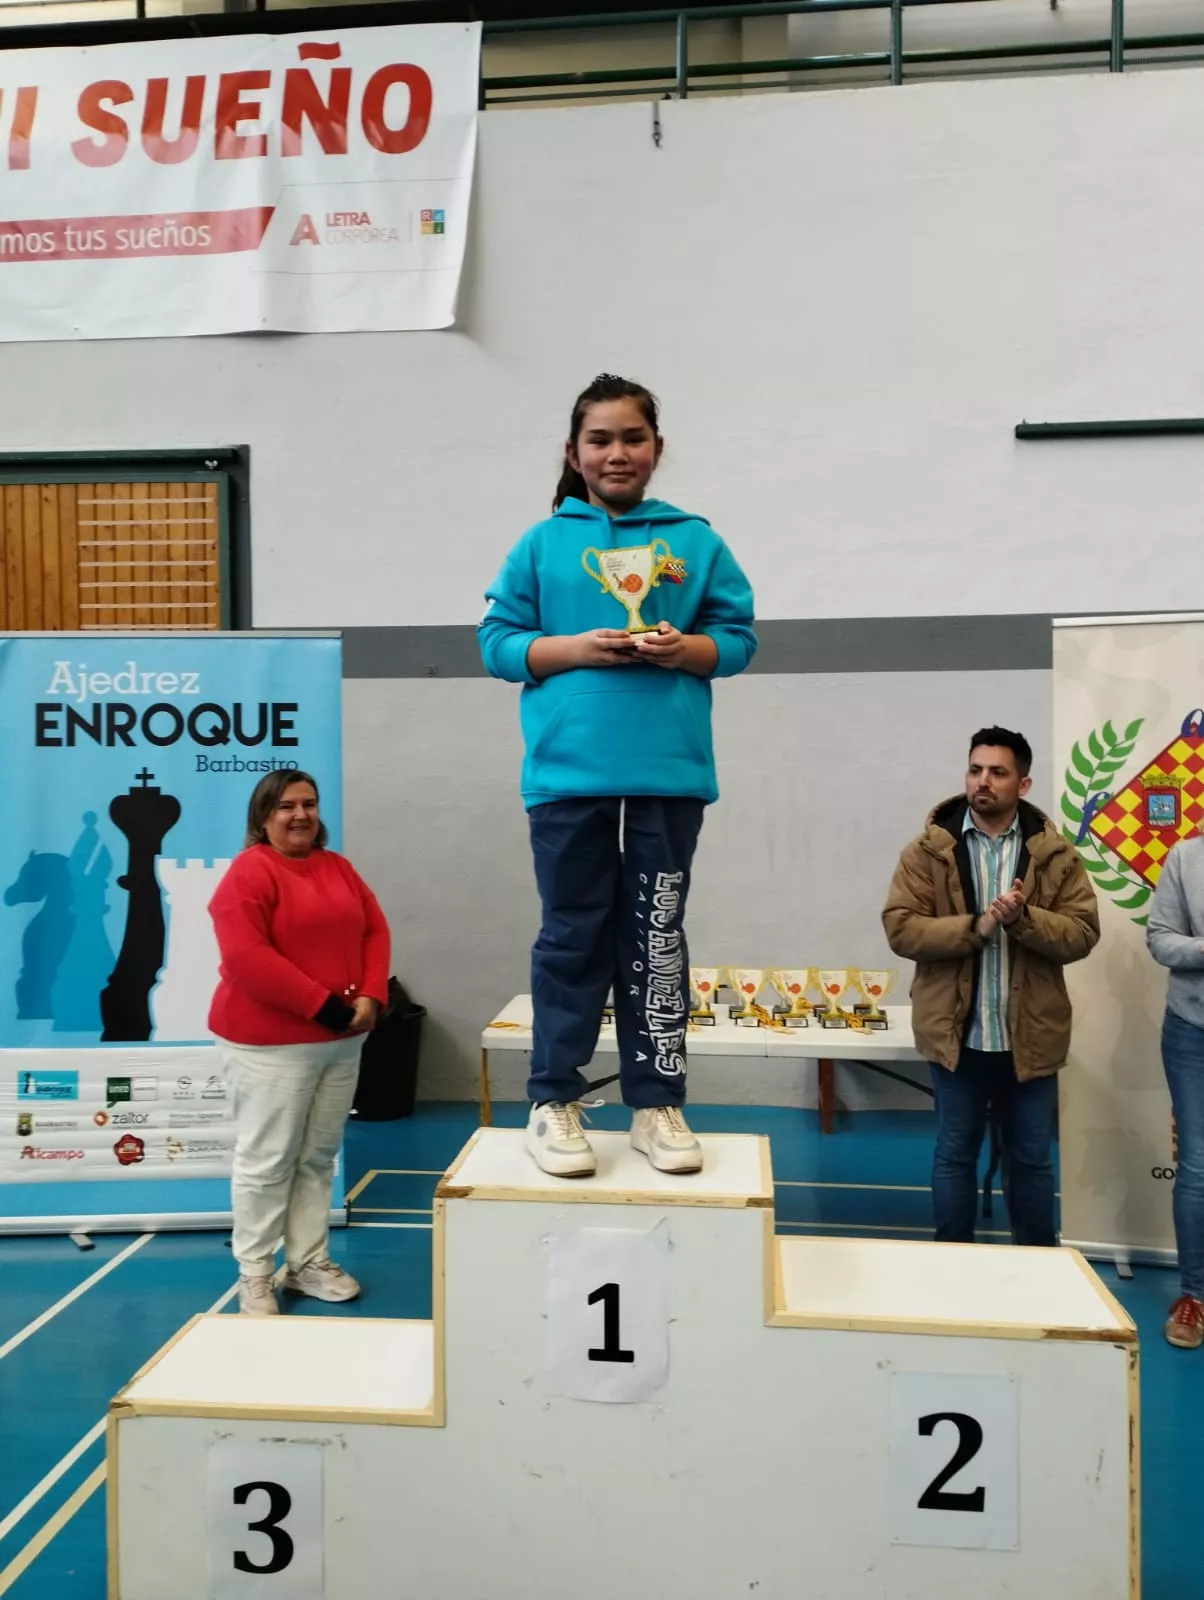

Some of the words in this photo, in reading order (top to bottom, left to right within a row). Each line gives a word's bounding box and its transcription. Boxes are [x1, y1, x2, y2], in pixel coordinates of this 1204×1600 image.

[0, 86, 38, 170] I
[70, 41, 433, 168] SUEÑO
[63, 225, 108, 252] tus
[114, 220, 212, 251] sueños
[325, 211, 371, 227] LETRA
[46, 661, 200, 702] Ajedrez
[35, 702, 299, 747] ENROQUE
[195, 755, 299, 773] Barbastro
[650, 871, 684, 930] LOS
[645, 929, 687, 1077] ANGELES
[1151, 1166, 1176, 1180] GO
[587, 1282, 635, 1363] 1
[917, 1412, 986, 1513] 2
[232, 1481, 295, 1575] 3
